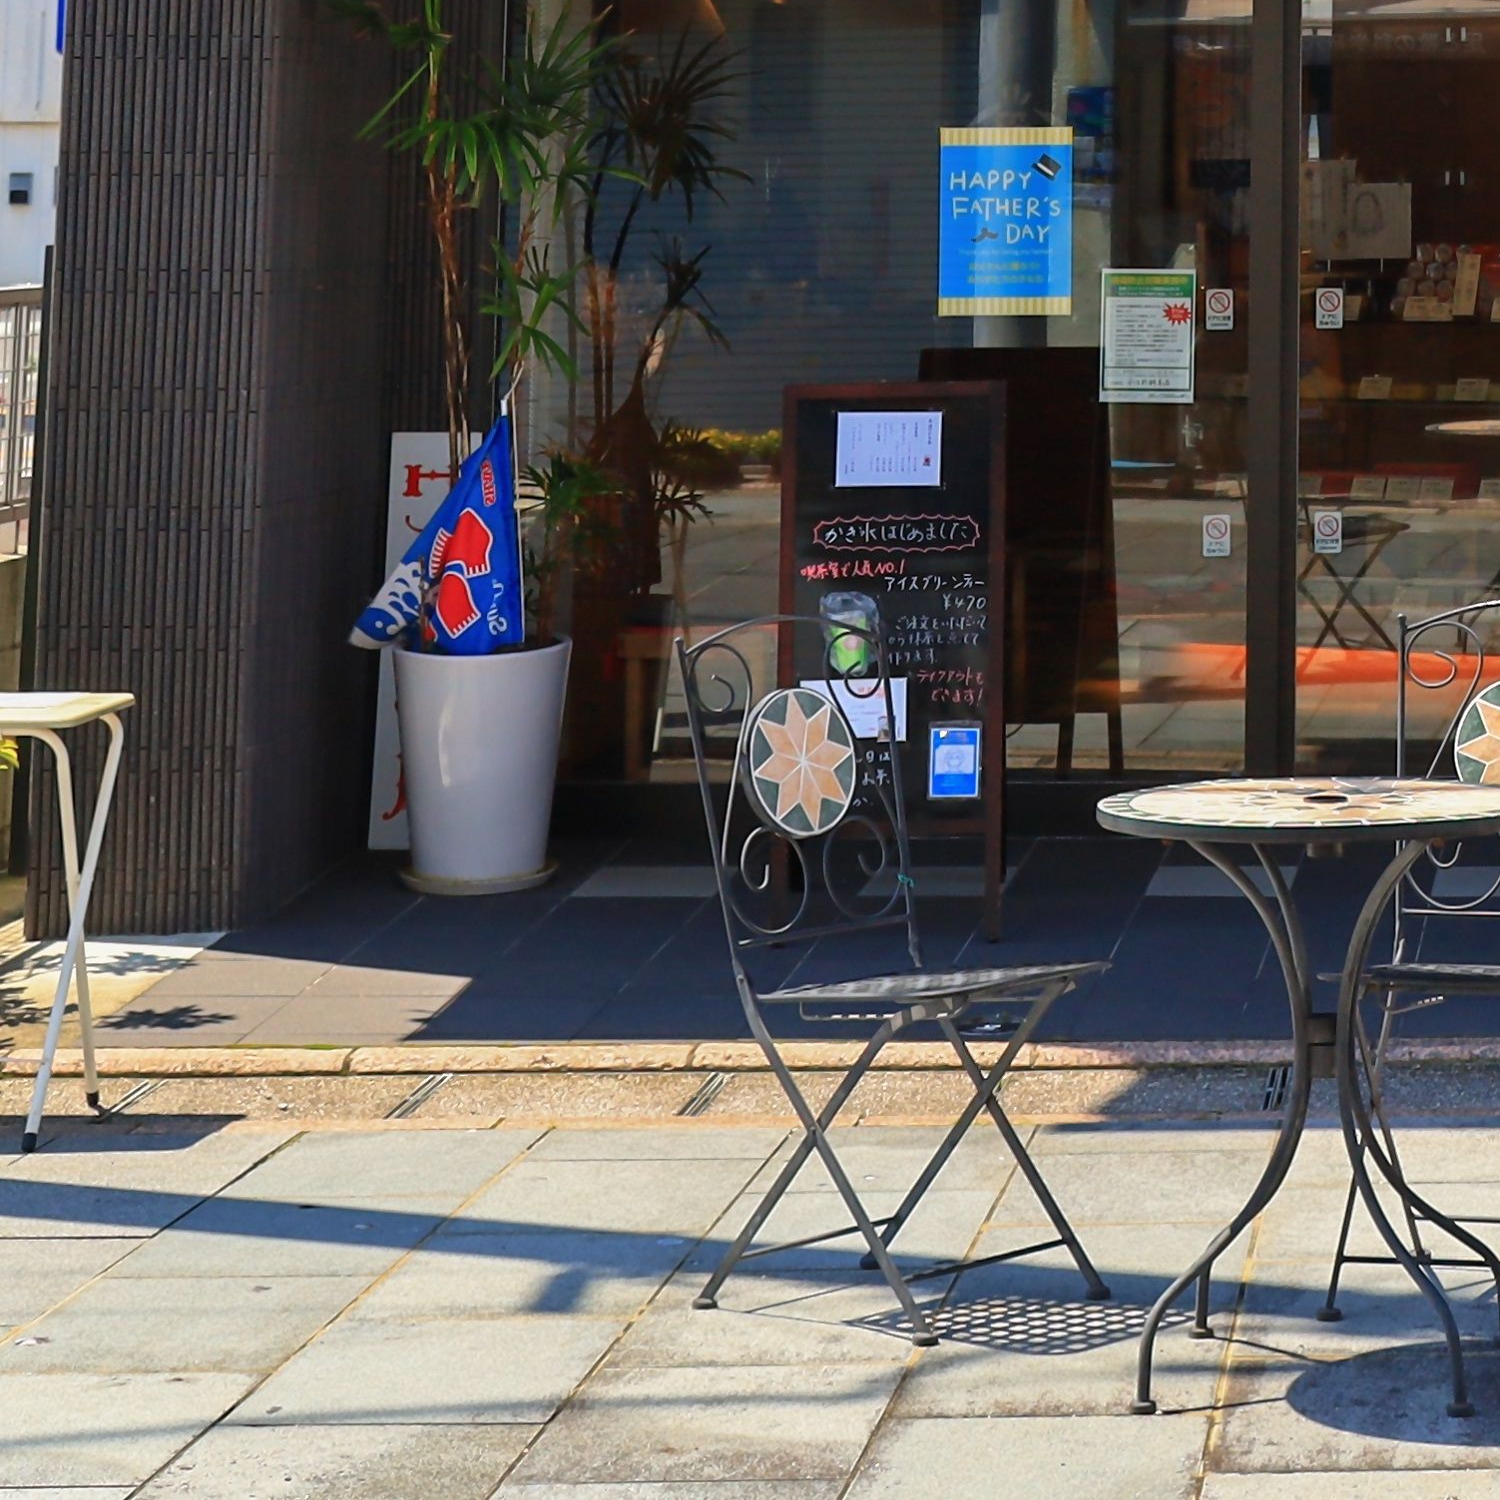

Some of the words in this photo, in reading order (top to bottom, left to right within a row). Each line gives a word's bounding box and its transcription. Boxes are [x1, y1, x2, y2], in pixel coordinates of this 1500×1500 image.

[949, 169, 1032, 191] HAPPY
[952, 196, 1063, 222] FATHER'S
[1005, 223, 1052, 245] DAY
[824, 520, 969, 544] かき氷はじめました
[942, 593, 987, 611] ¥470
